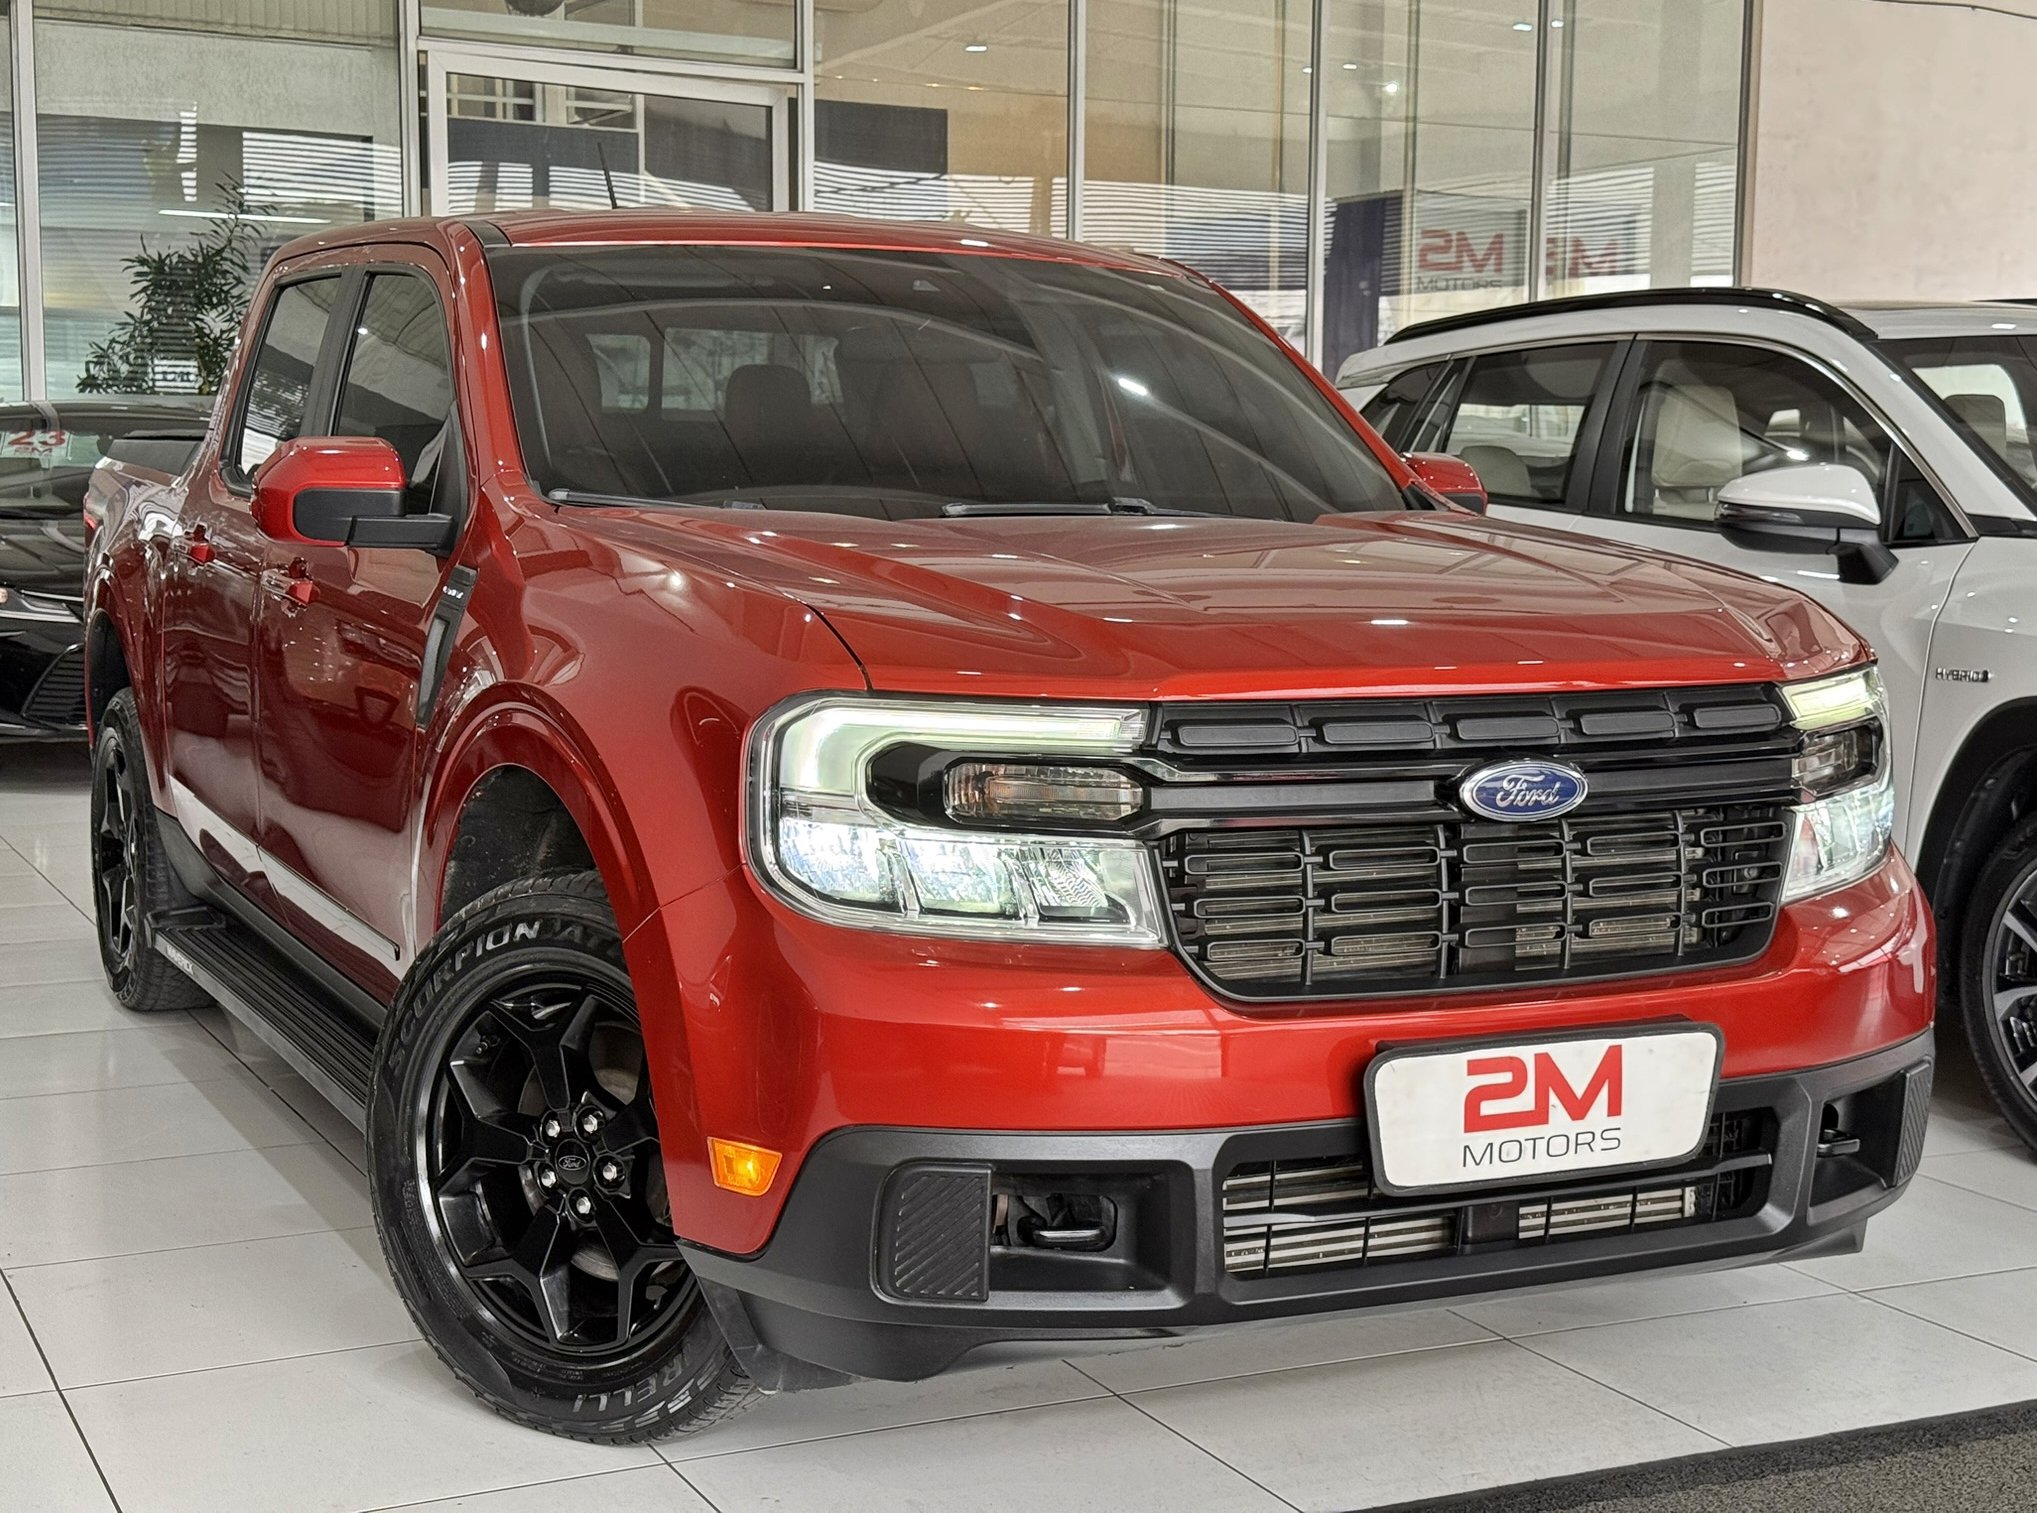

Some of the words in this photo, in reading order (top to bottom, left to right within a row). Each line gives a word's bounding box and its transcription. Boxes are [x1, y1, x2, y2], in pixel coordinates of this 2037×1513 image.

[1415, 276, 1504, 291] MOTORS
[8, 429, 66, 446] 23
[1935, 667, 1981, 682] HYBRID
[1496, 774, 1561, 808] Ford
[387, 917, 544, 1077] SCORPION
[1463, 1044, 1623, 1134] 2M
[1462, 1127, 1622, 1168] MOTORS
